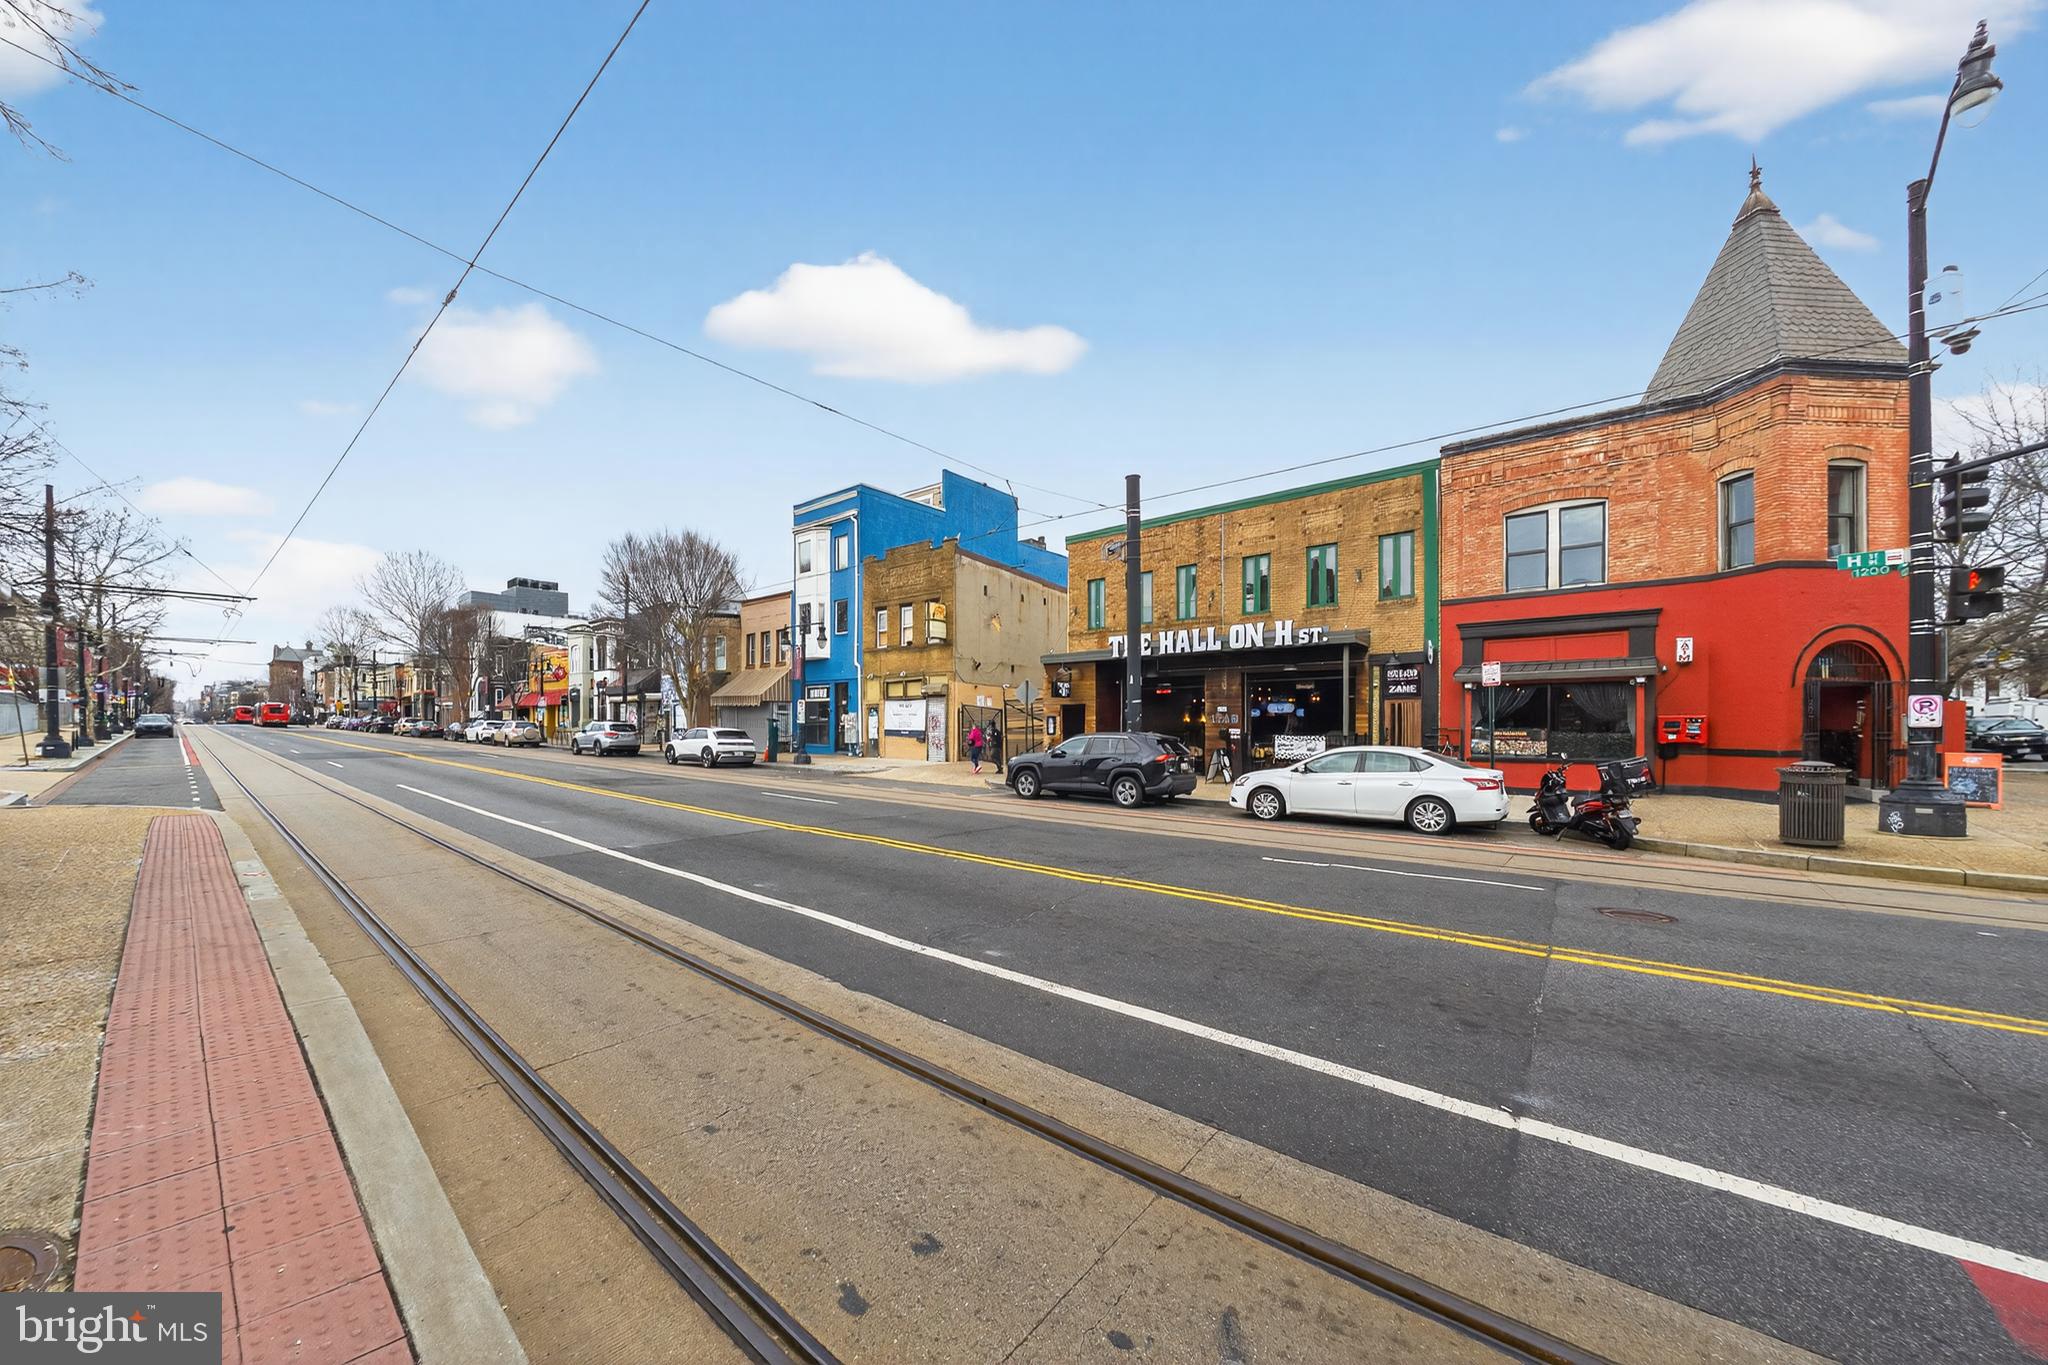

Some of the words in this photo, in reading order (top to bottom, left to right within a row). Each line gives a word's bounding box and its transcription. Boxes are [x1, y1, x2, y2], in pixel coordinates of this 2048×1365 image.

[1847, 555, 1862, 568] H
[1853, 565, 1890, 578] 1200
[1108, 633, 1152, 658] TE
[1159, 626, 1222, 656] HALL
[1229, 622, 1266, 649] ON
[1274, 619, 1294, 647] H
